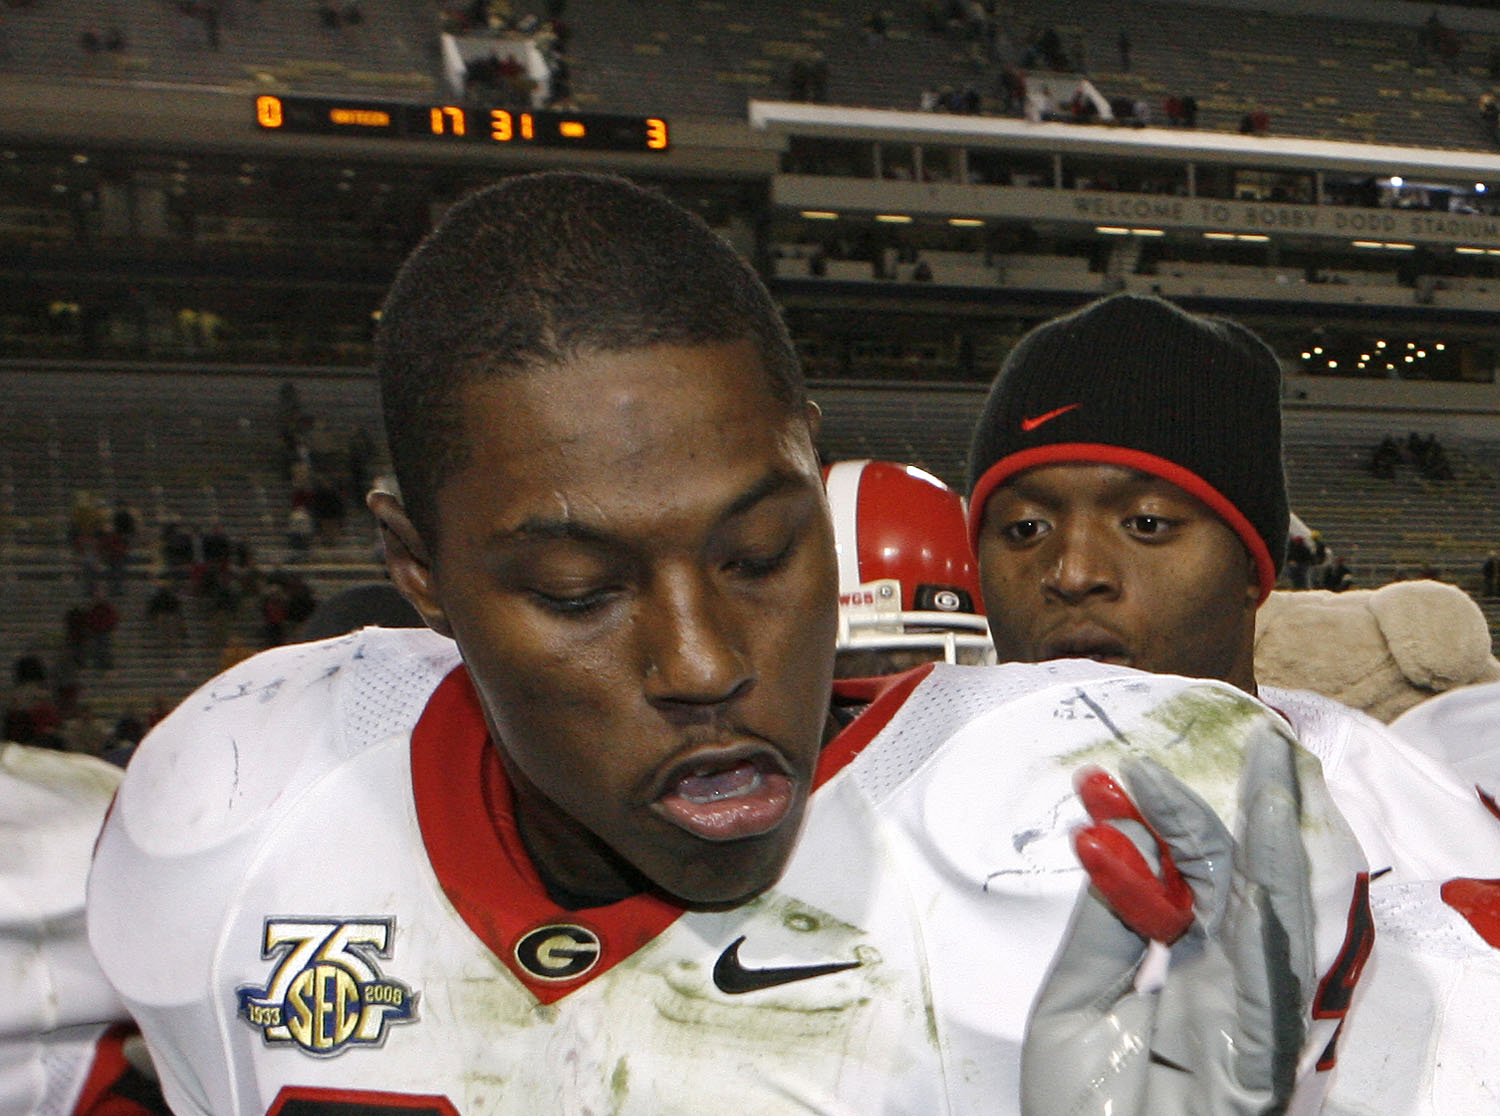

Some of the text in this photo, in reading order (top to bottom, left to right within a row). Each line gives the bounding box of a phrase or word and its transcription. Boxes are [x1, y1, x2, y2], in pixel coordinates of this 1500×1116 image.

[430, 106, 466, 136] 17
[491, 110, 534, 141] 31
[646, 118, 668, 149] 3
[1076, 198, 1182, 220] WELCOME
[1201, 203, 1231, 222] TO
[1246, 206, 1317, 228] BOBBY
[1335, 211, 1396, 232] DODD
[1410, 215, 1498, 237] STADIUM
[249, 965, 404, 1049] 1933 SEC 2008
[265, 919, 389, 1042] 75
